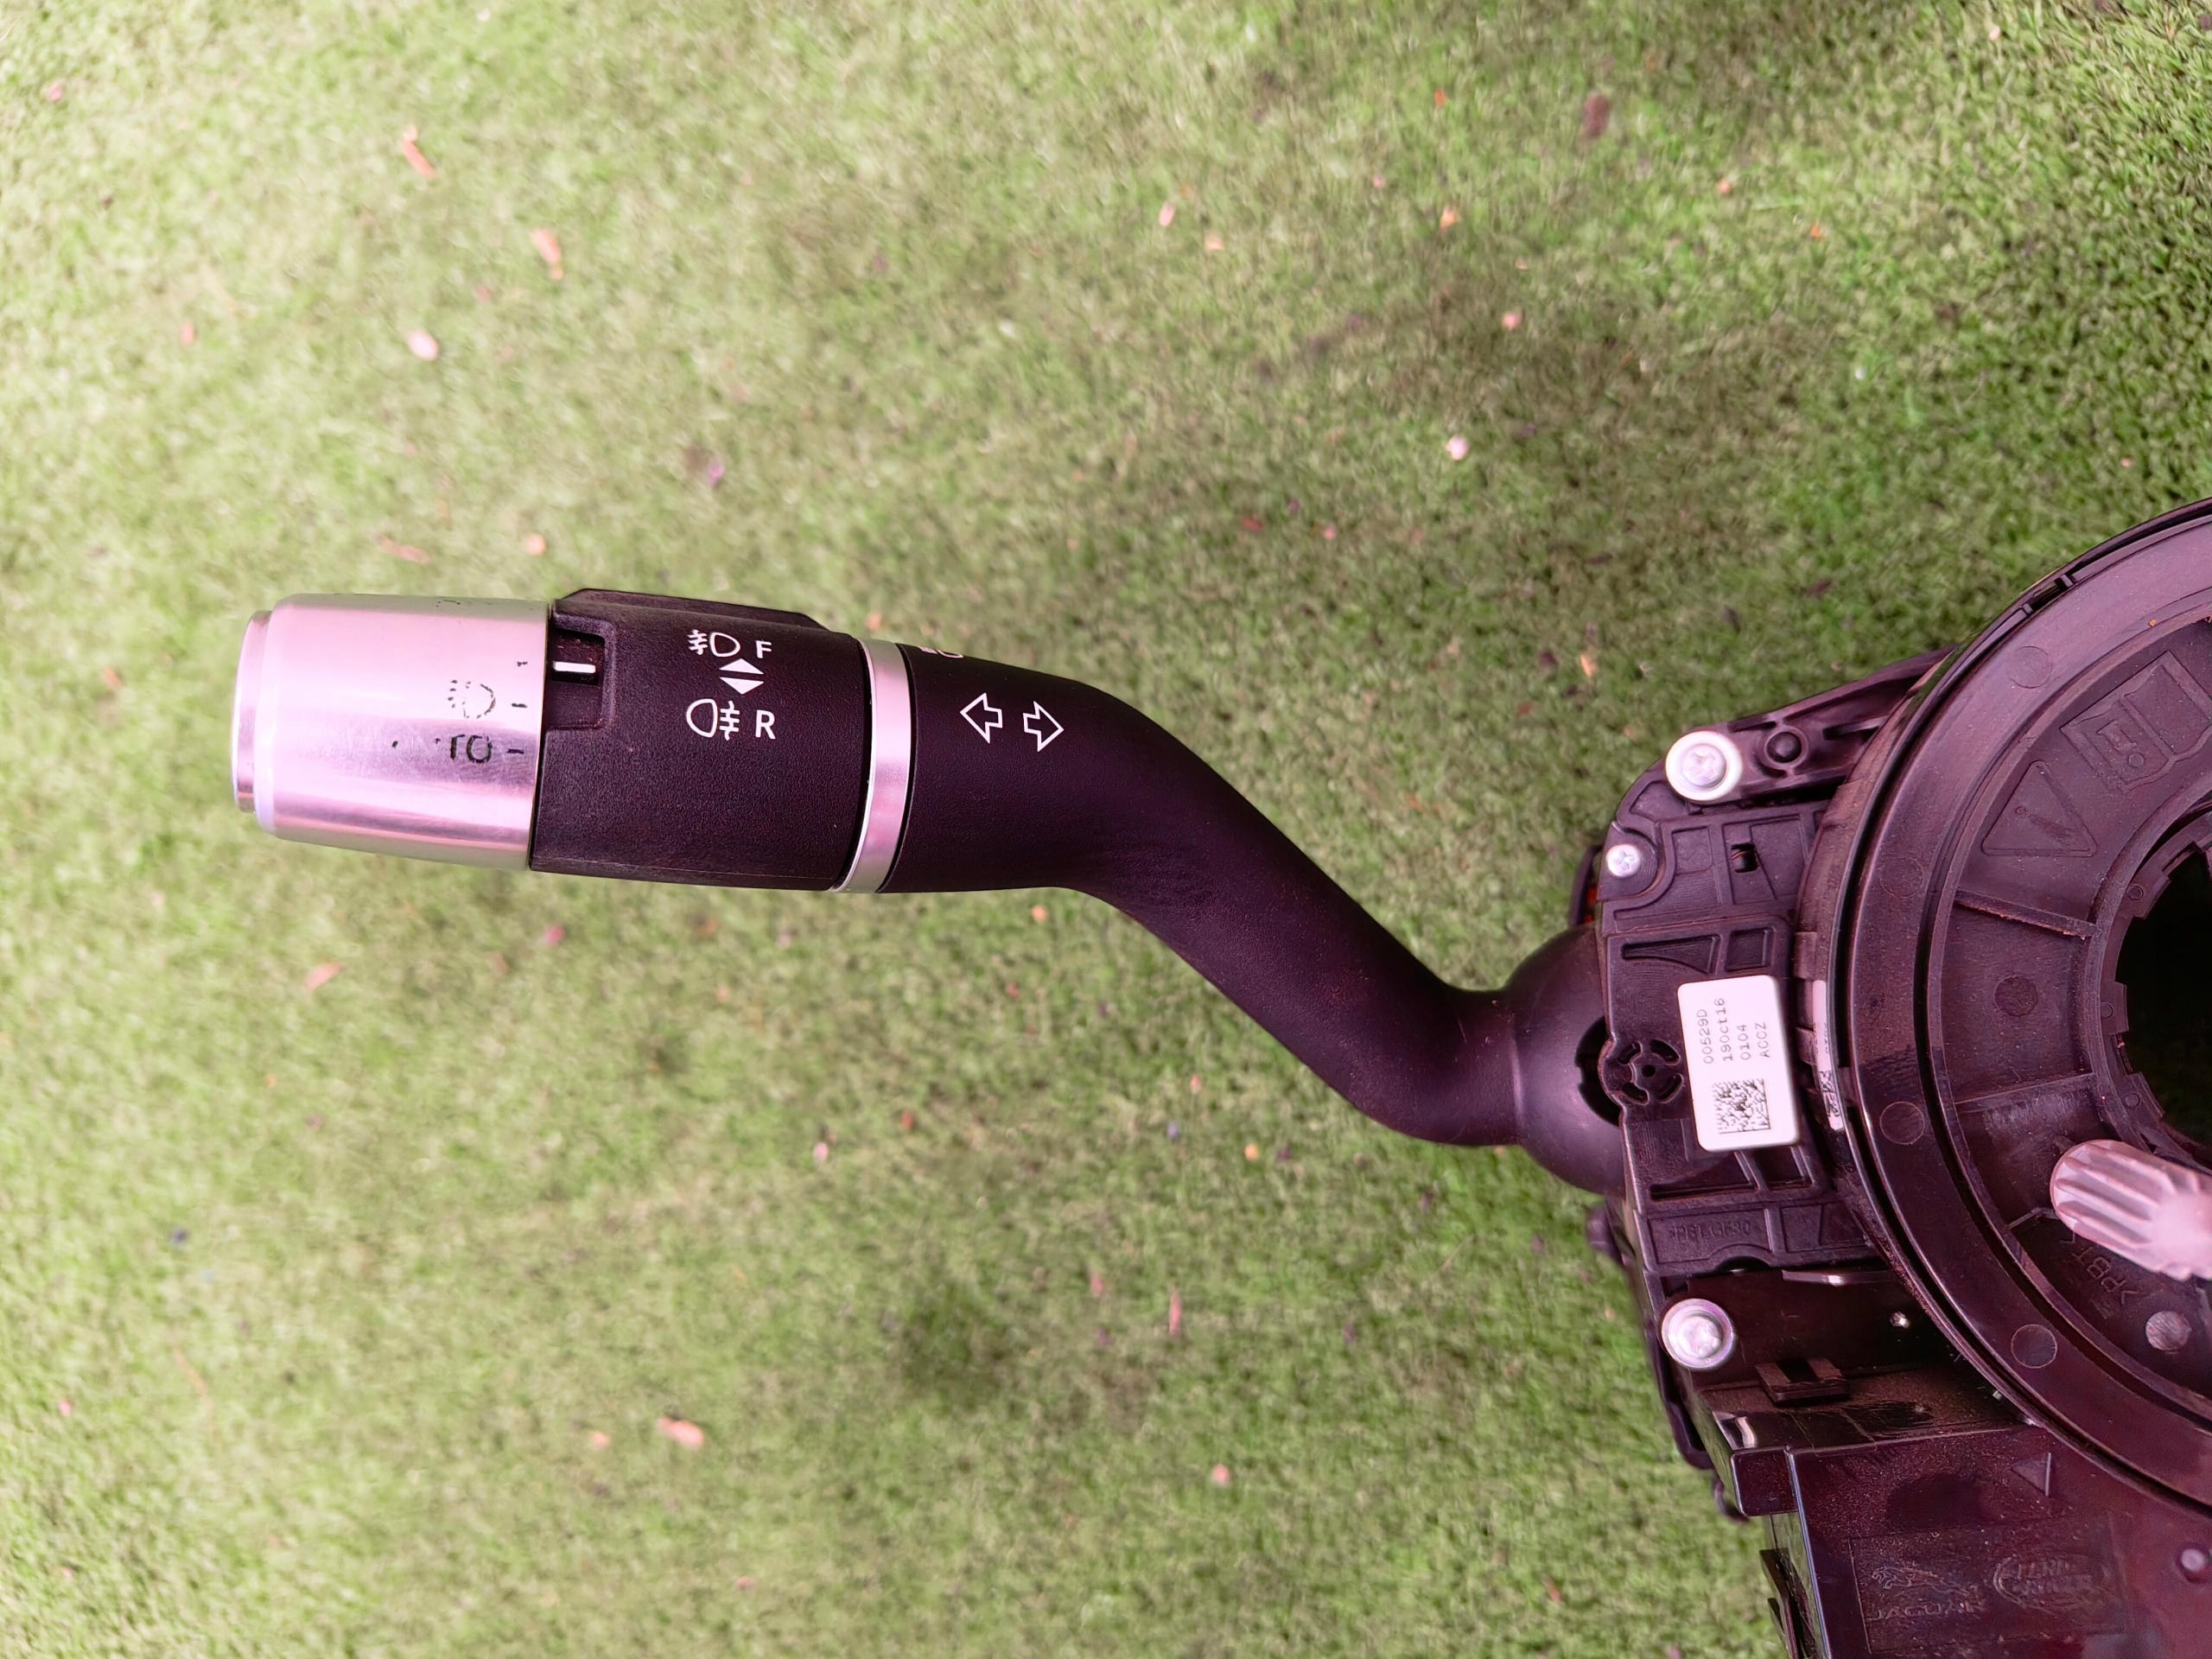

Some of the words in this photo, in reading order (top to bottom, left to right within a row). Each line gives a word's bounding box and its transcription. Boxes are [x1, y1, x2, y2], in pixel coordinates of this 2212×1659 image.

[755, 639, 772, 659] F
[755, 709, 776, 740] R
[1736, 1023, 1751, 1061] 0104
[1754, 1021, 1770, 1058] ACCZ
